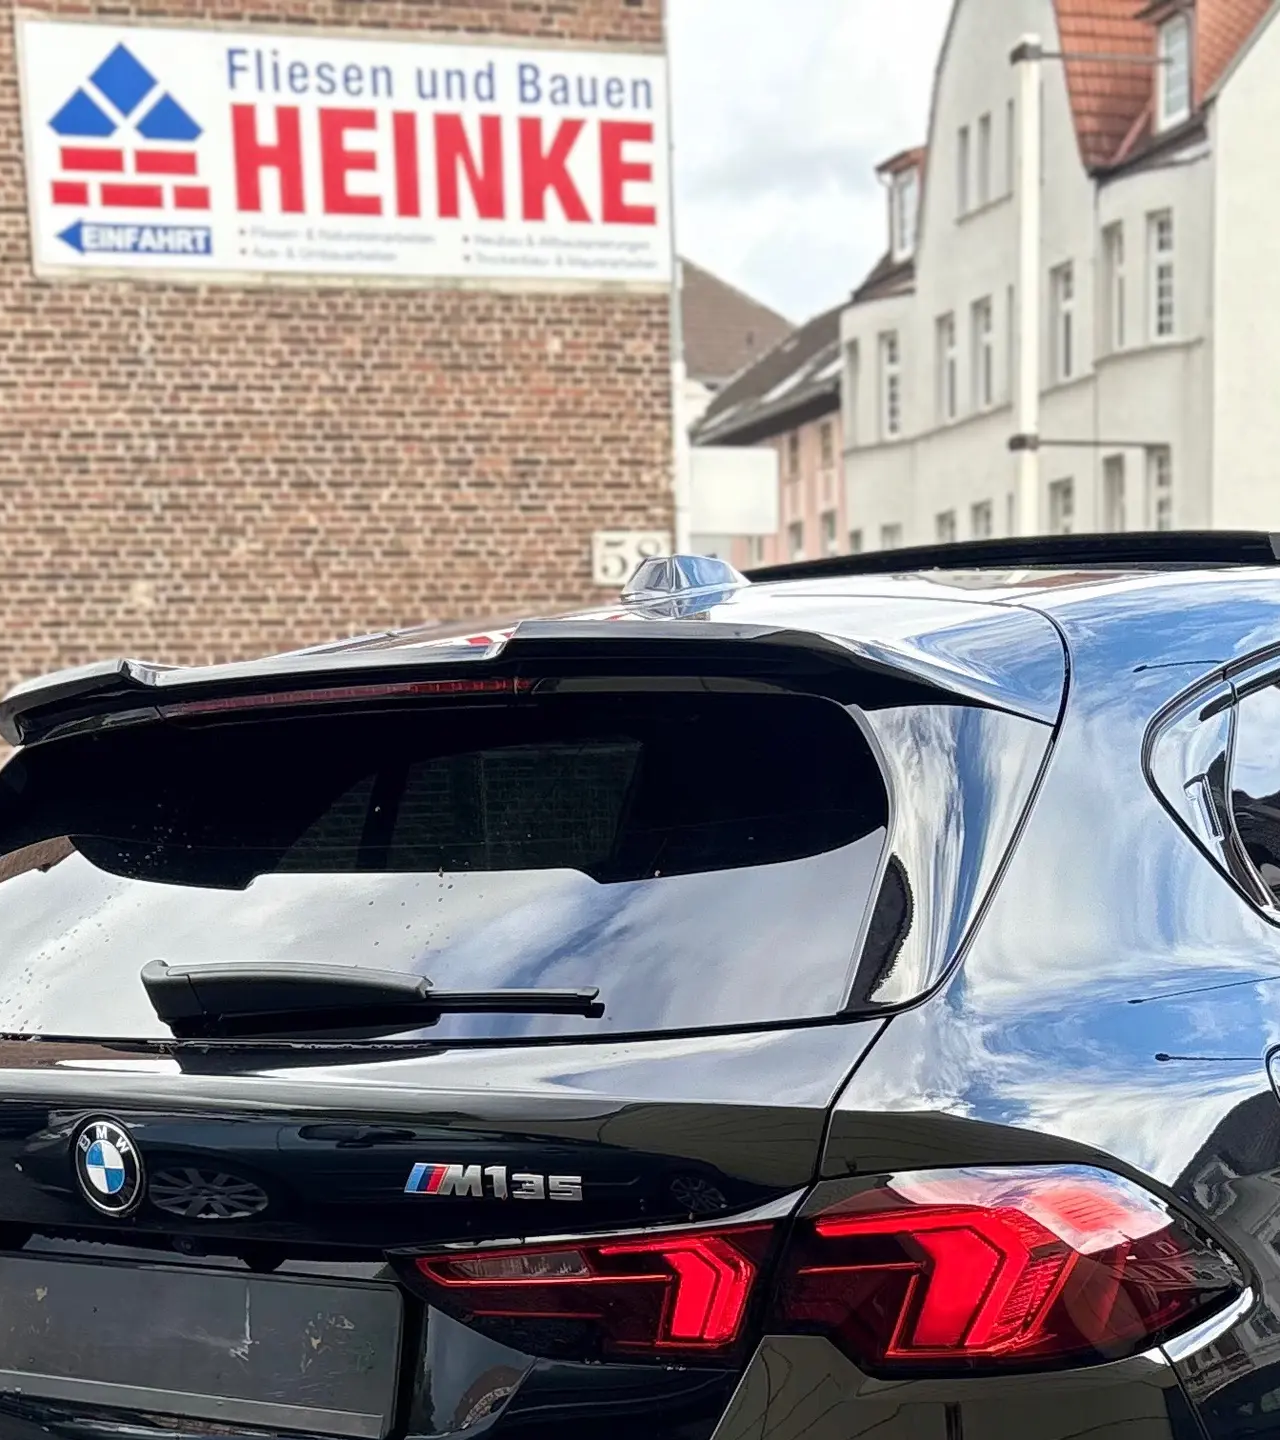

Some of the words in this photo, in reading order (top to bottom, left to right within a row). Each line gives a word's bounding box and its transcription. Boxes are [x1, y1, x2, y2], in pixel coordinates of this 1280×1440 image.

[226, 48, 395, 98] Fliesen
[417, 58, 497, 103] und
[517, 62, 654, 111] Bauen
[230, 103, 658, 227] HEINKE
[80, 224, 209, 255] EINFAHRT
[79, 1124, 131, 1154] BMW
[436, 1164, 583, 1201] M135
